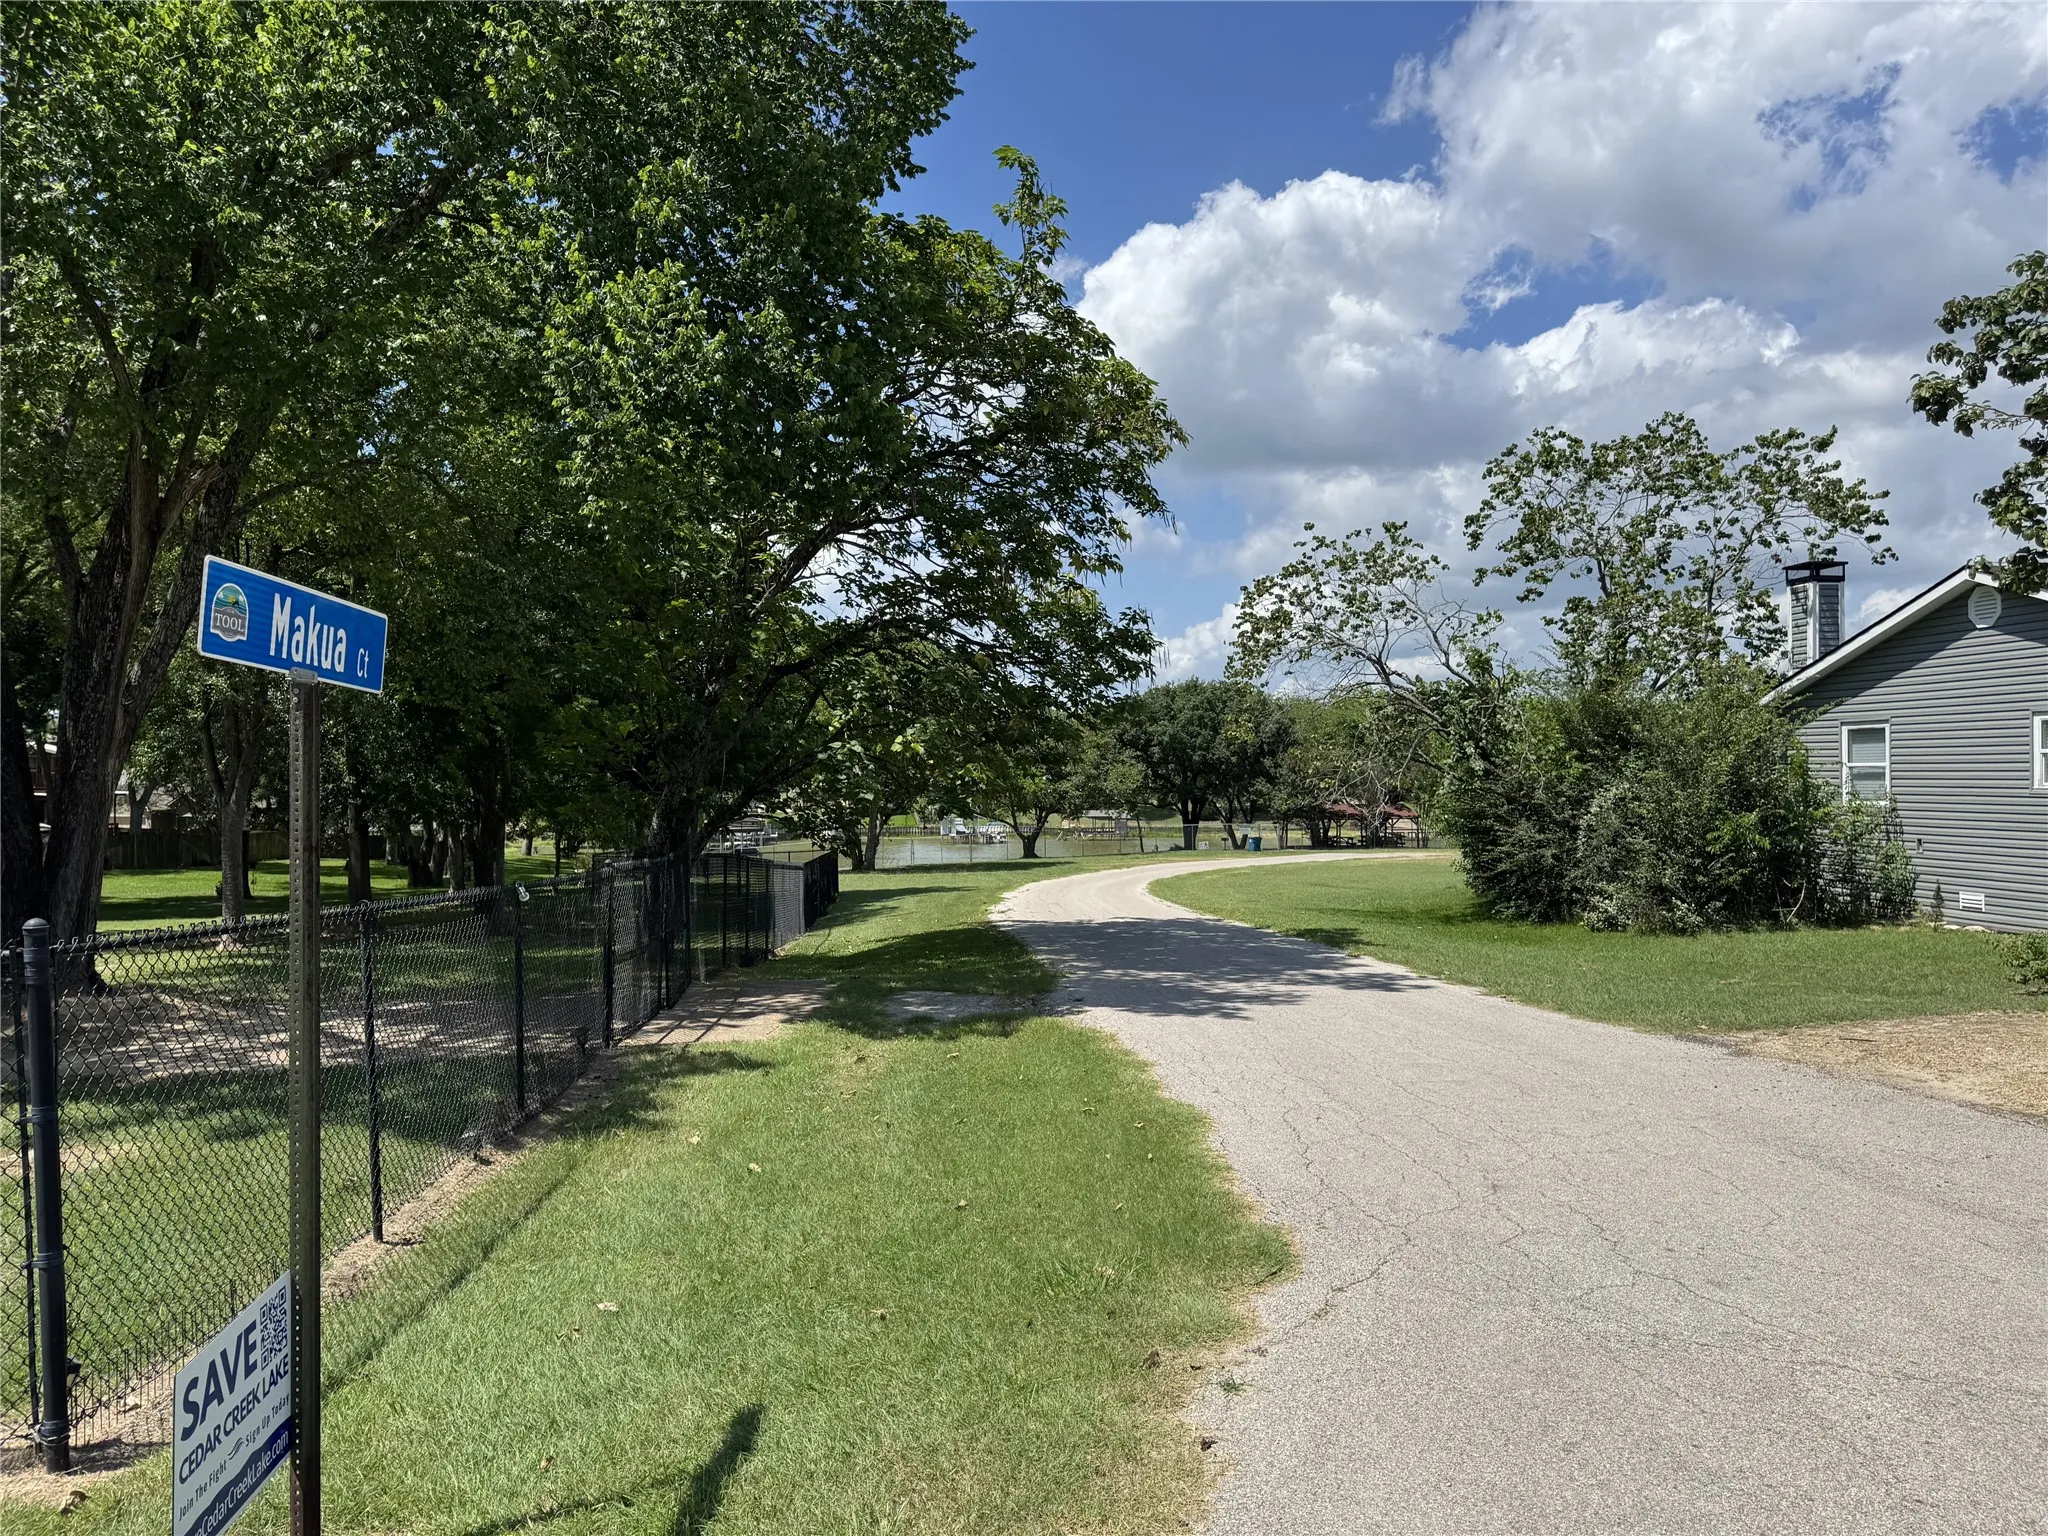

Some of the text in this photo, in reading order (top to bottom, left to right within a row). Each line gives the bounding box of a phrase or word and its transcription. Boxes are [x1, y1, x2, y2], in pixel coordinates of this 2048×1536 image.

[214, 612, 245, 632] TOOL
[269, 592, 369, 679] Makua Ct
[180, 1319, 258, 1442] SAVE
[179, 1352, 289, 1485] CEDAR CREEK LAKE
[245, 1393, 290, 1448] Sign Up Today
[178, 1459, 227, 1522] Join The Fight
